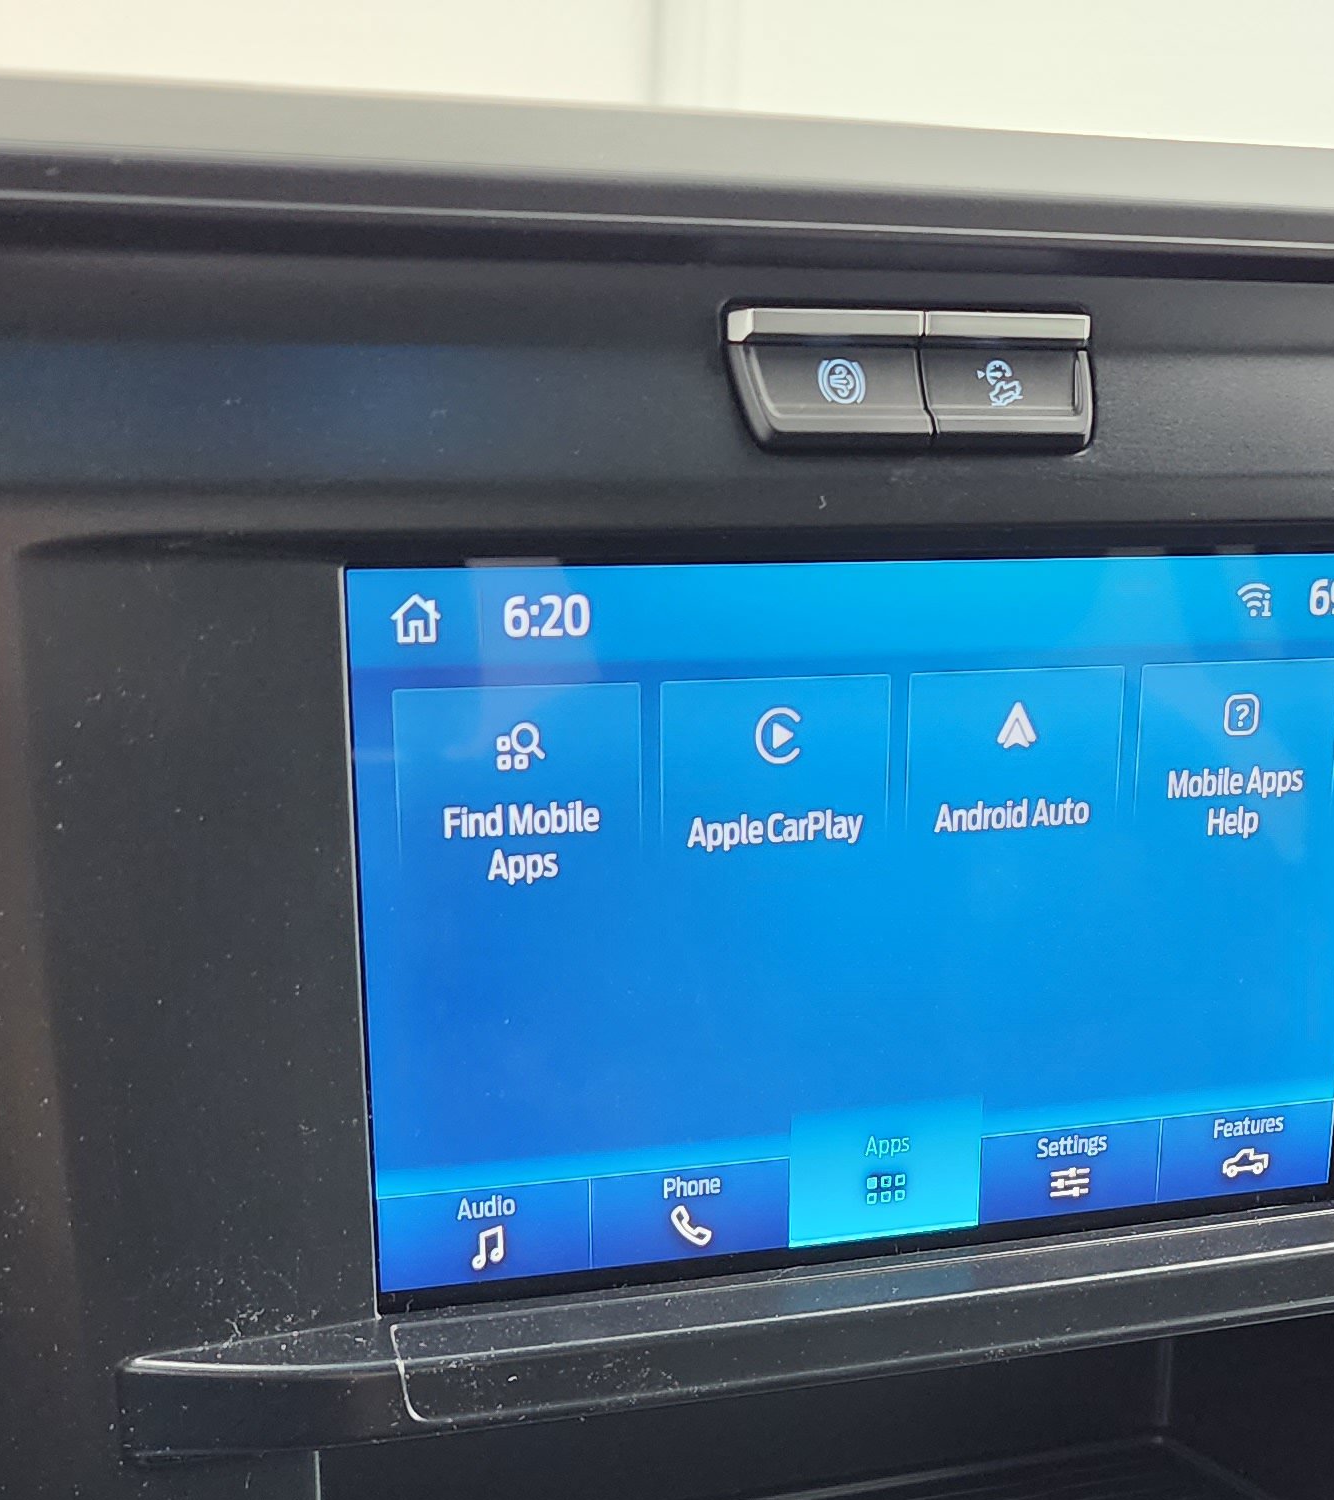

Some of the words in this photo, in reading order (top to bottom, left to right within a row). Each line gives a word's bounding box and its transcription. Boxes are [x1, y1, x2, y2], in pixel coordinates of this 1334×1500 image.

[503, 593, 591, 638] 6:20
[1167, 767, 1244, 800] Mobile
[1246, 765, 1305, 797] Apps
[443, 803, 504, 840] Find
[508, 799, 601, 837] Mobile
[686, 816, 764, 853] Apple
[766, 808, 865, 846] CarPlay
[933, 798, 1028, 834] Android
[1030, 797, 1091, 828] Auto
[1206, 806, 1260, 840] Help
[487, 848, 559, 886] Apps
[1212, 1113, 1285, 1141] Features
[865, 1134, 910, 1159] Apps
[1036, 1132, 1108, 1160] Settings
[662, 1173, 722, 1200] Phone
[456, 1194, 516, 1222] Audio
